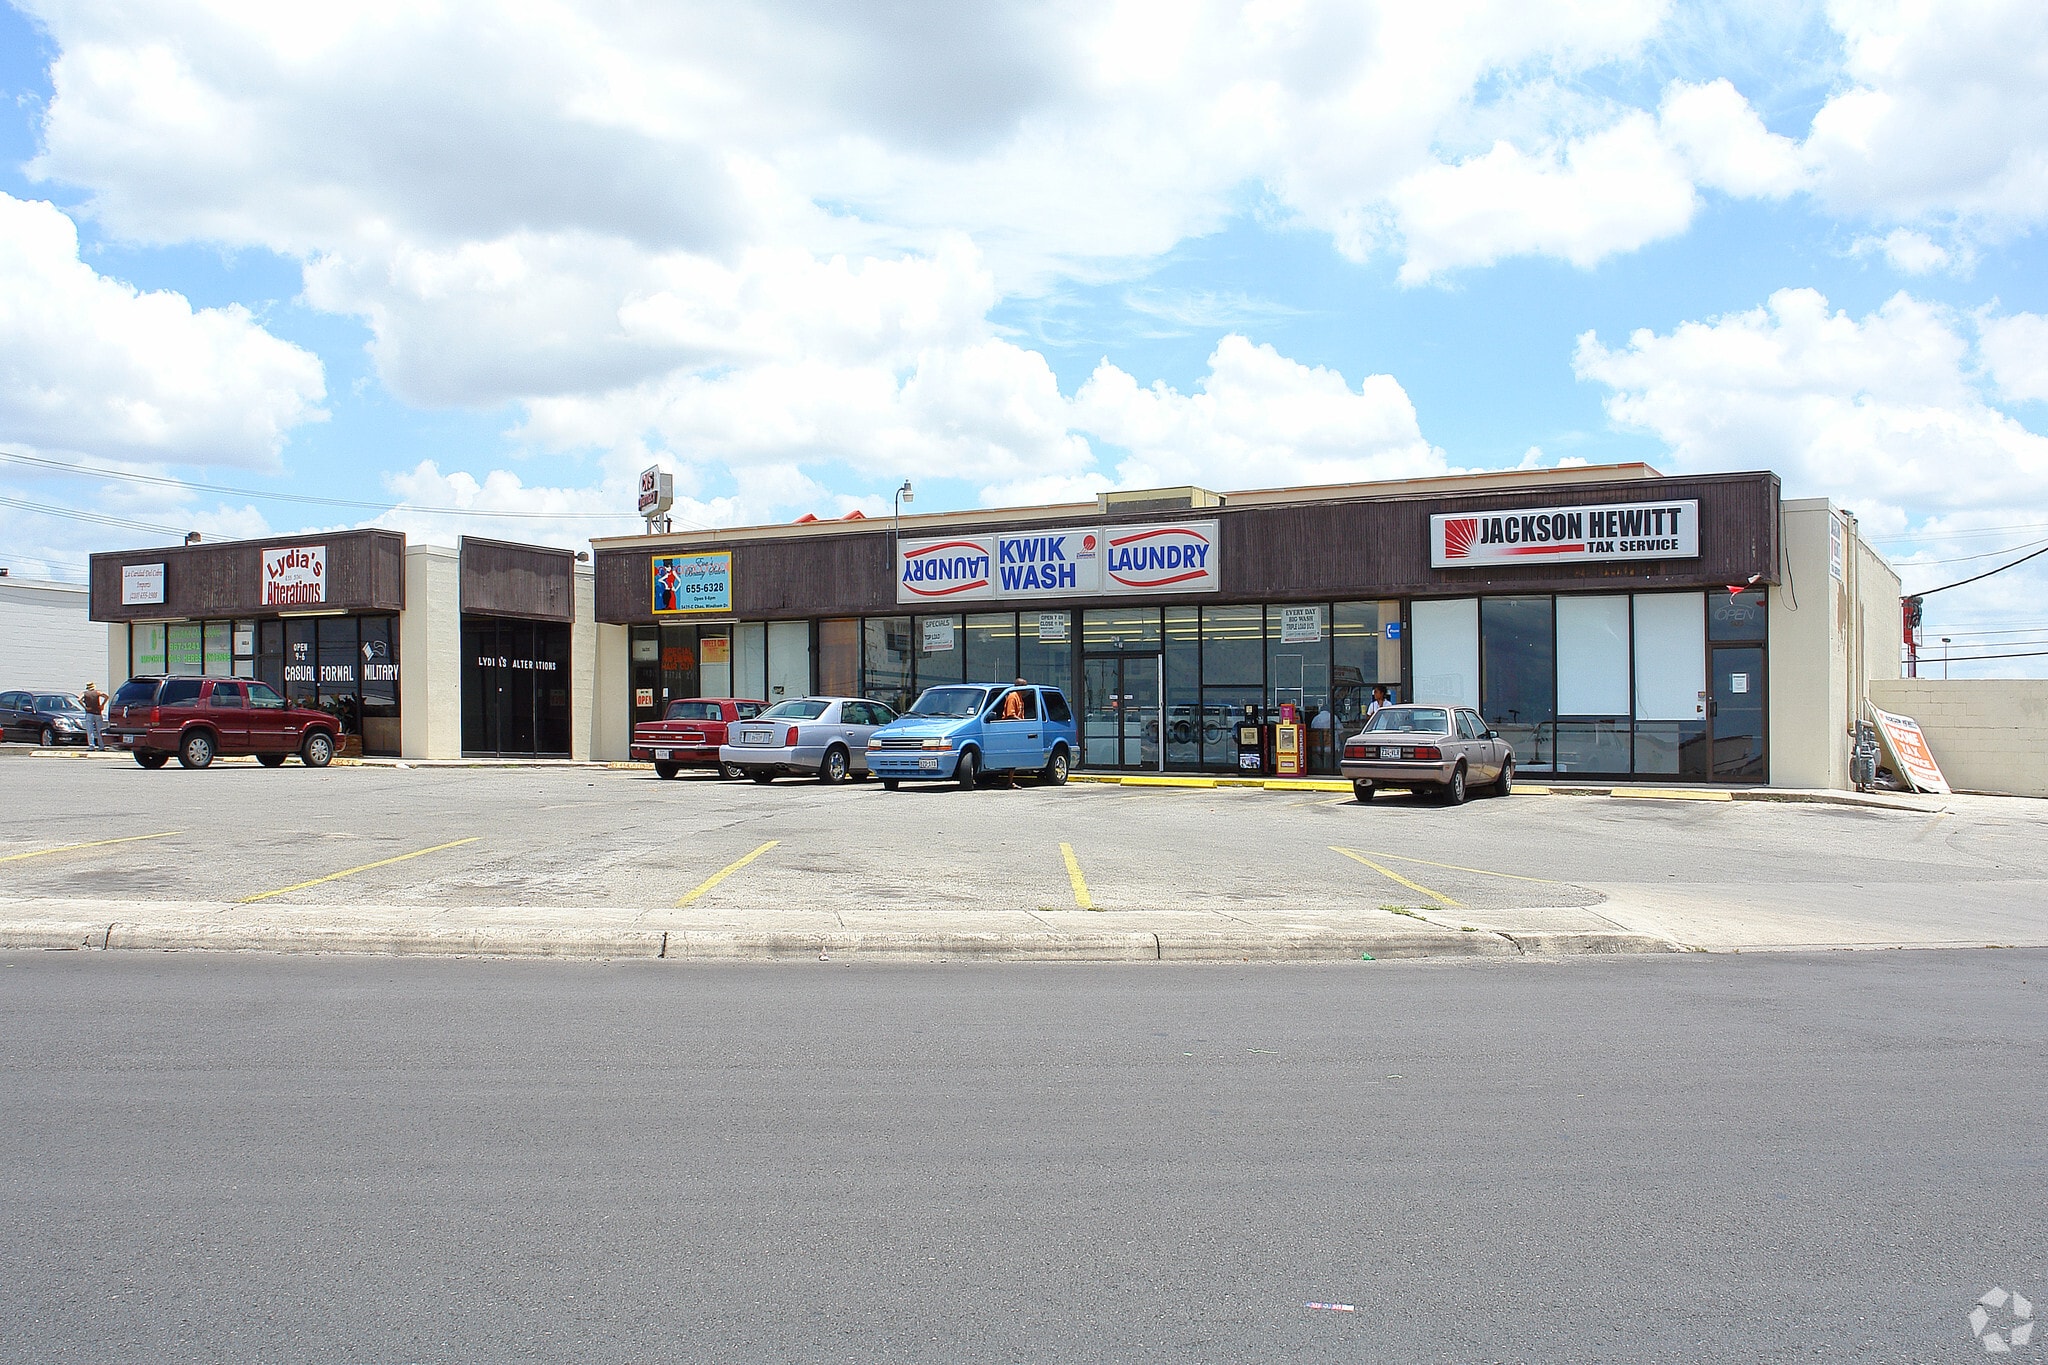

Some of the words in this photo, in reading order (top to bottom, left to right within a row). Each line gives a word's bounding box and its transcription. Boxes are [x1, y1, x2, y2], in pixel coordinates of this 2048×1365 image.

[1481, 512, 1582, 544] JACKSON
[1589, 507, 1682, 538] HEWITT
[1000, 536, 1066, 564] KWIK
[1587, 541, 1614, 553] TAX
[1620, 539, 1679, 552] SERVICE
[266, 549, 323, 579] Lydia's
[1108, 544, 1210, 571] LAUNDRY
[902, 556, 989, 582] LAUNDRY
[1000, 562, 1076, 590] WASH
[267, 580, 320, 606] Alterations
[686, 583, 724, 593] 655-6328
[1717, 609, 1755, 620] OPEN
[925, 620, 950, 628] SPECIALS
[293, 643, 308, 651] OPEN
[284, 665, 315, 681] CASUAL
[320, 665, 354, 681] FORMAL
[364, 664, 399, 680] MILITARY
[512, 660, 556, 671] ALTERATIONS
[637, 695, 652, 705] OPEN
